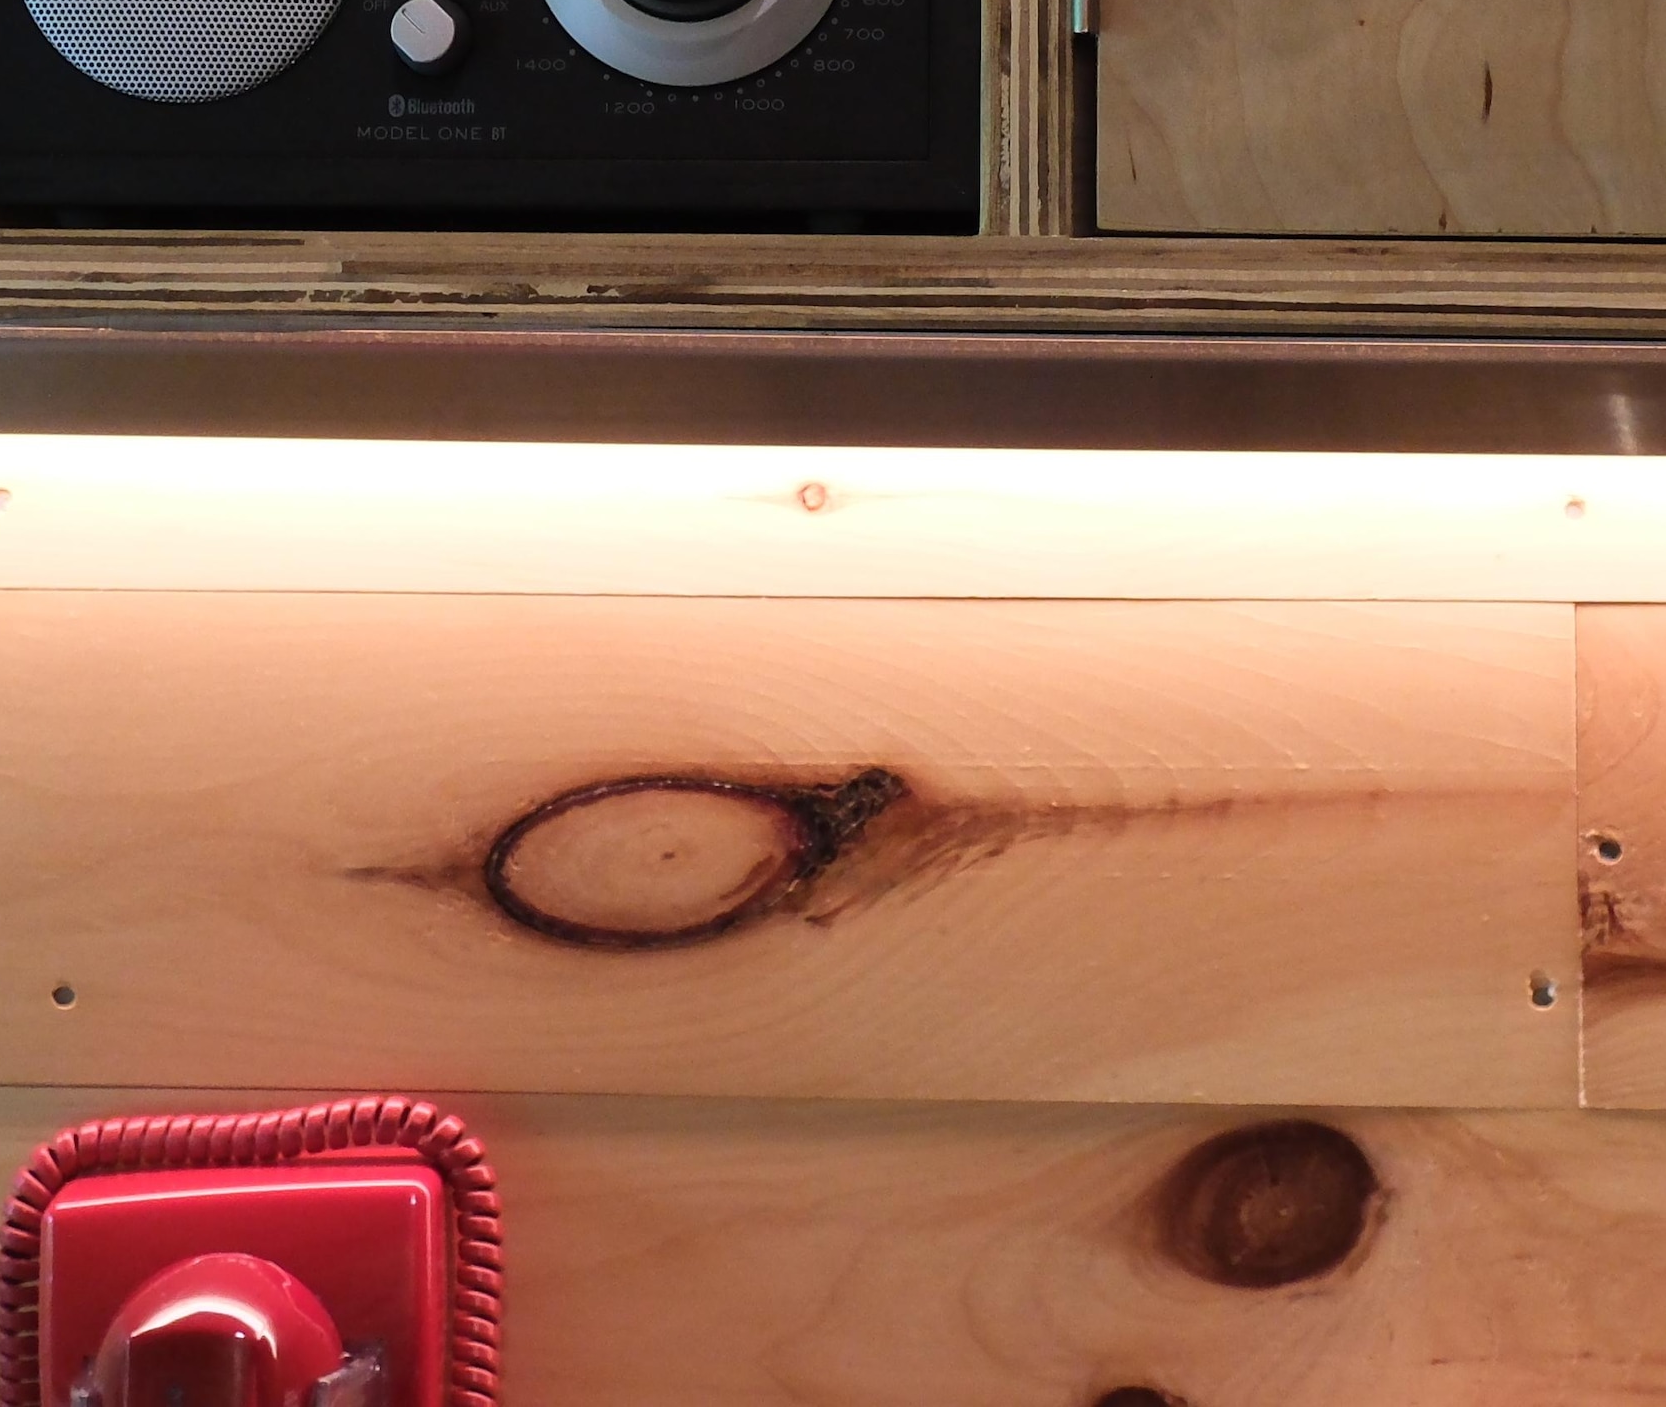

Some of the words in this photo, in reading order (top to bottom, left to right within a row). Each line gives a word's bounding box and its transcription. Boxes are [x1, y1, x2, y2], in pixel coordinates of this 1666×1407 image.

[479, 0, 510, 12] AUX
[844, 27, 885, 41] 700
[515, 58, 567, 71] 1400
[813, 59, 855, 73] 800
[407, 98, 476, 115] Bluetooth
[604, 101, 656, 115] 1200
[734, 98, 785, 112] 1000
[356, 126, 431, 141] MODEL
[438, 126, 483, 141] ONE
[491, 126, 508, 141] BT
